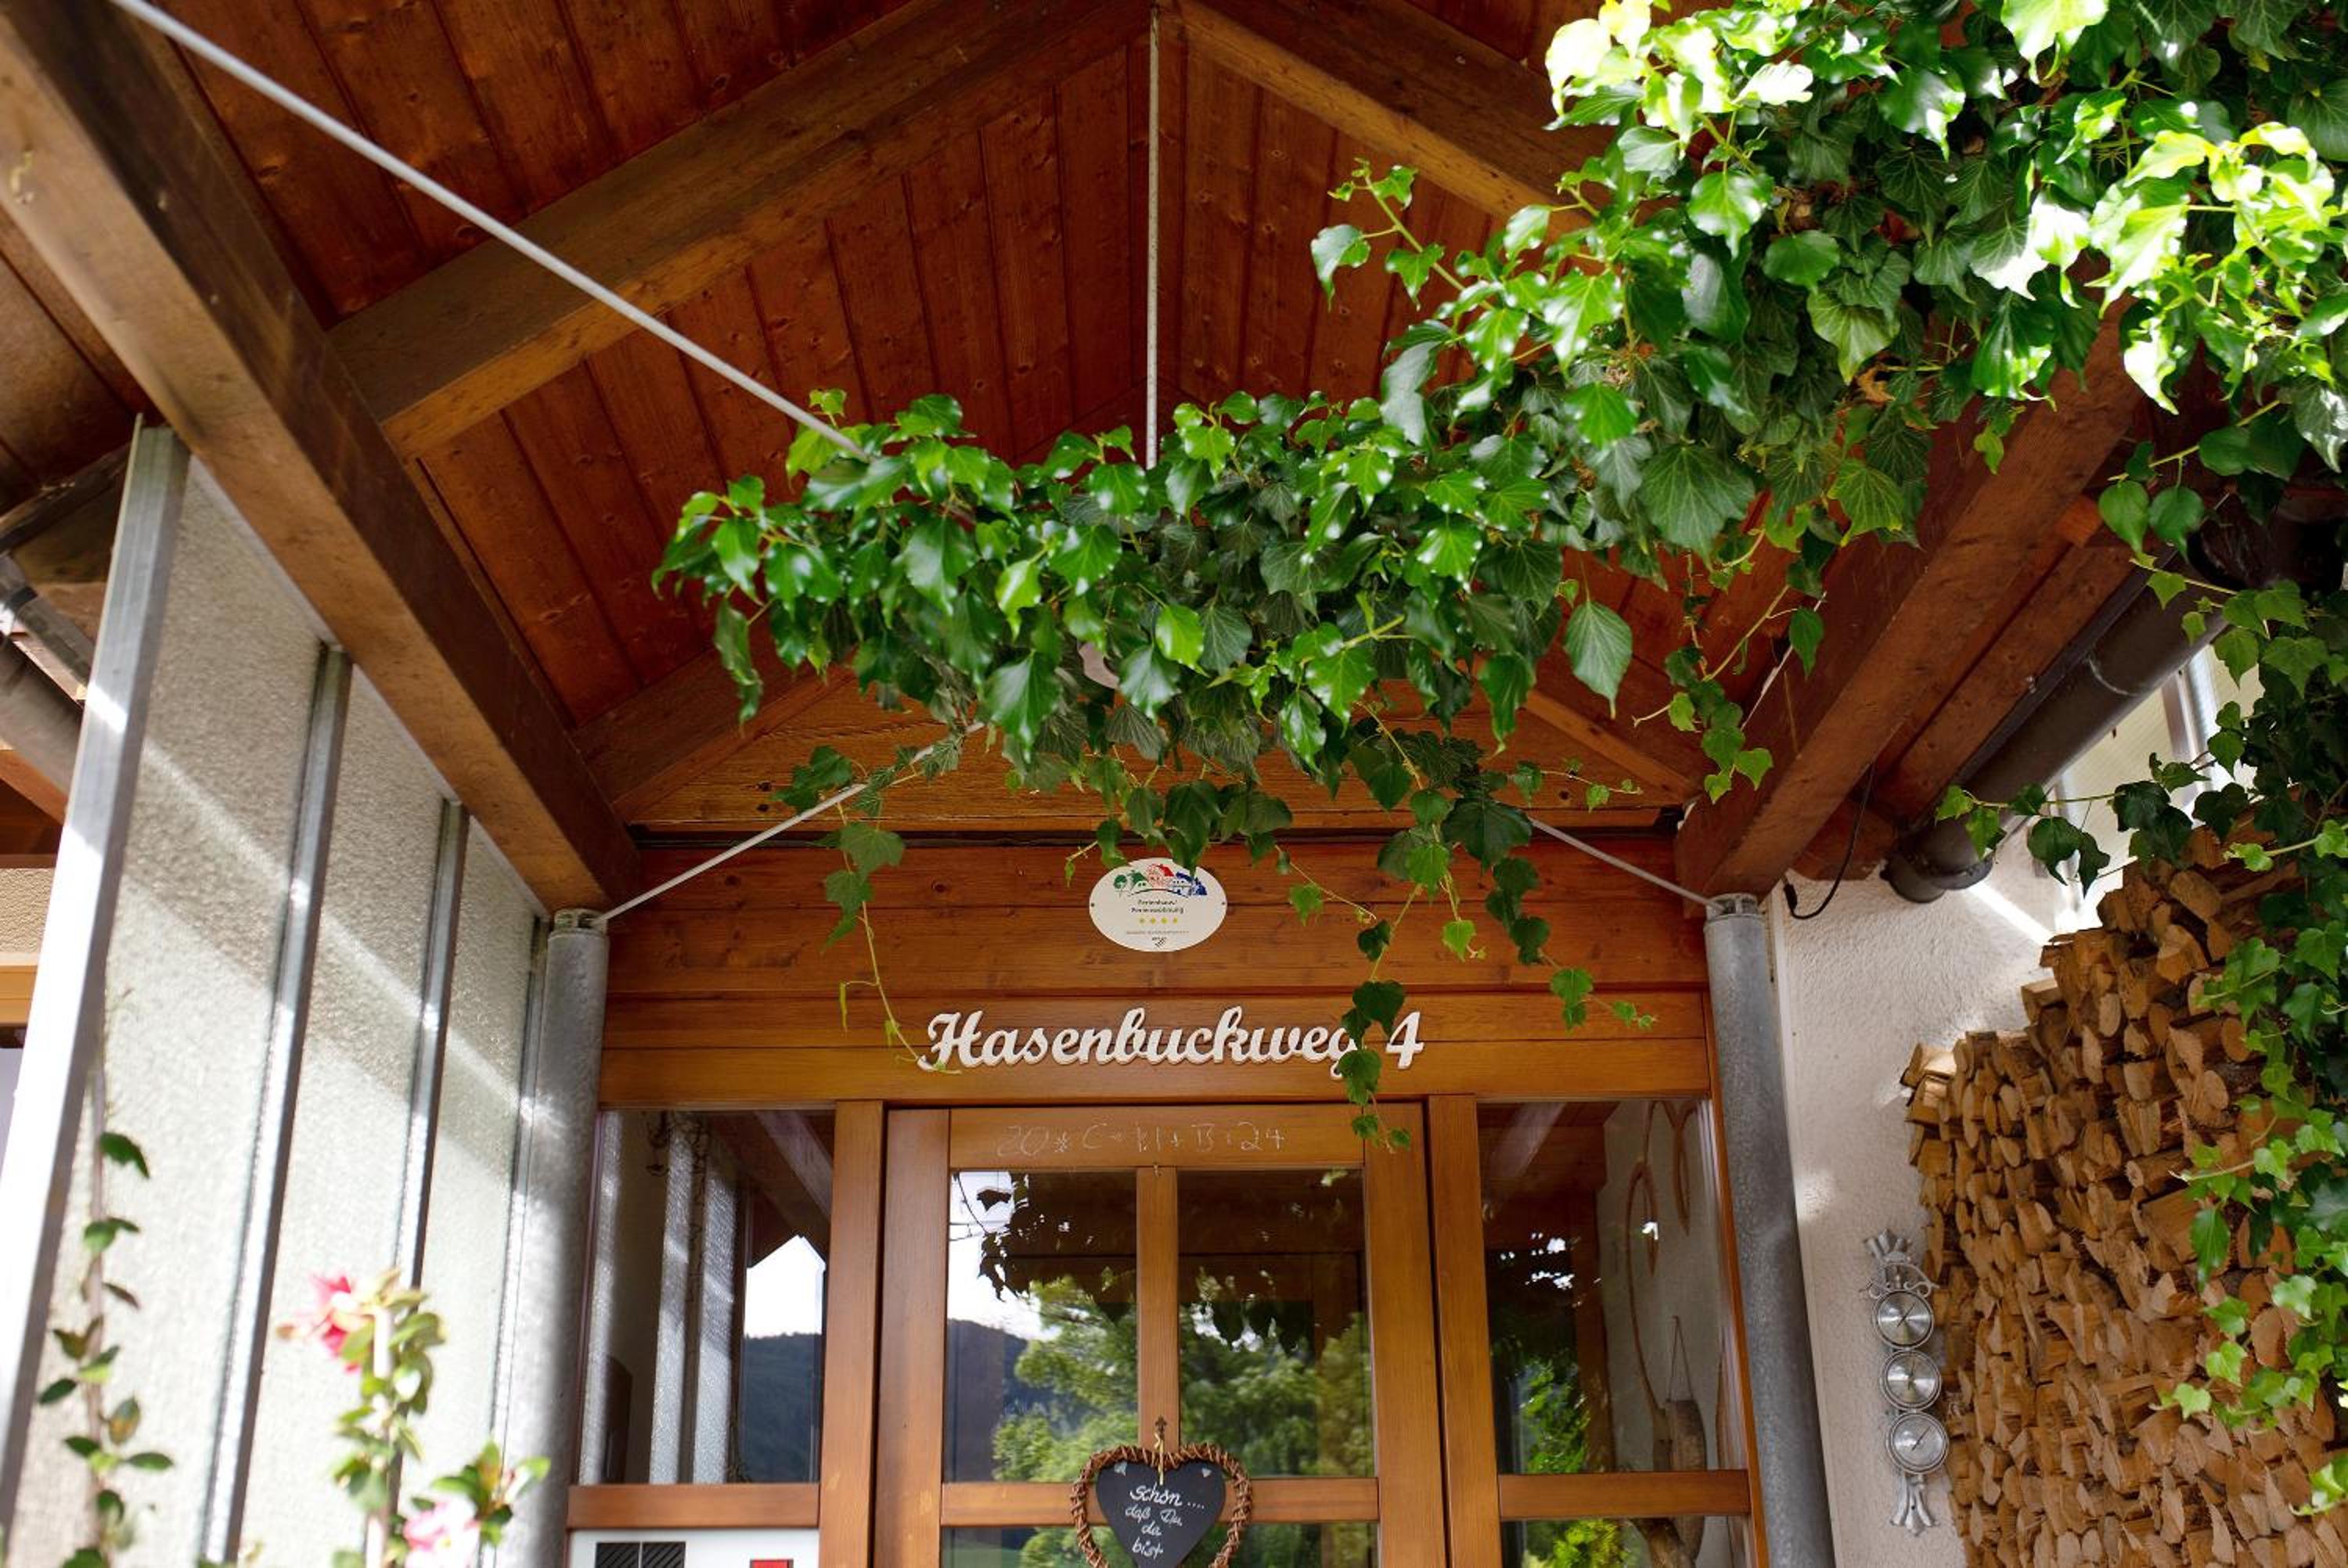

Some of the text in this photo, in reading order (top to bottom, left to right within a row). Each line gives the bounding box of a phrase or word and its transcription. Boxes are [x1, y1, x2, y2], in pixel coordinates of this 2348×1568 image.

[917, 1006, 1424, 1080] Hasenbuckweg 4
[1141, 1520, 1162, 1536] da
[1132, 1537, 1163, 1559] bist
